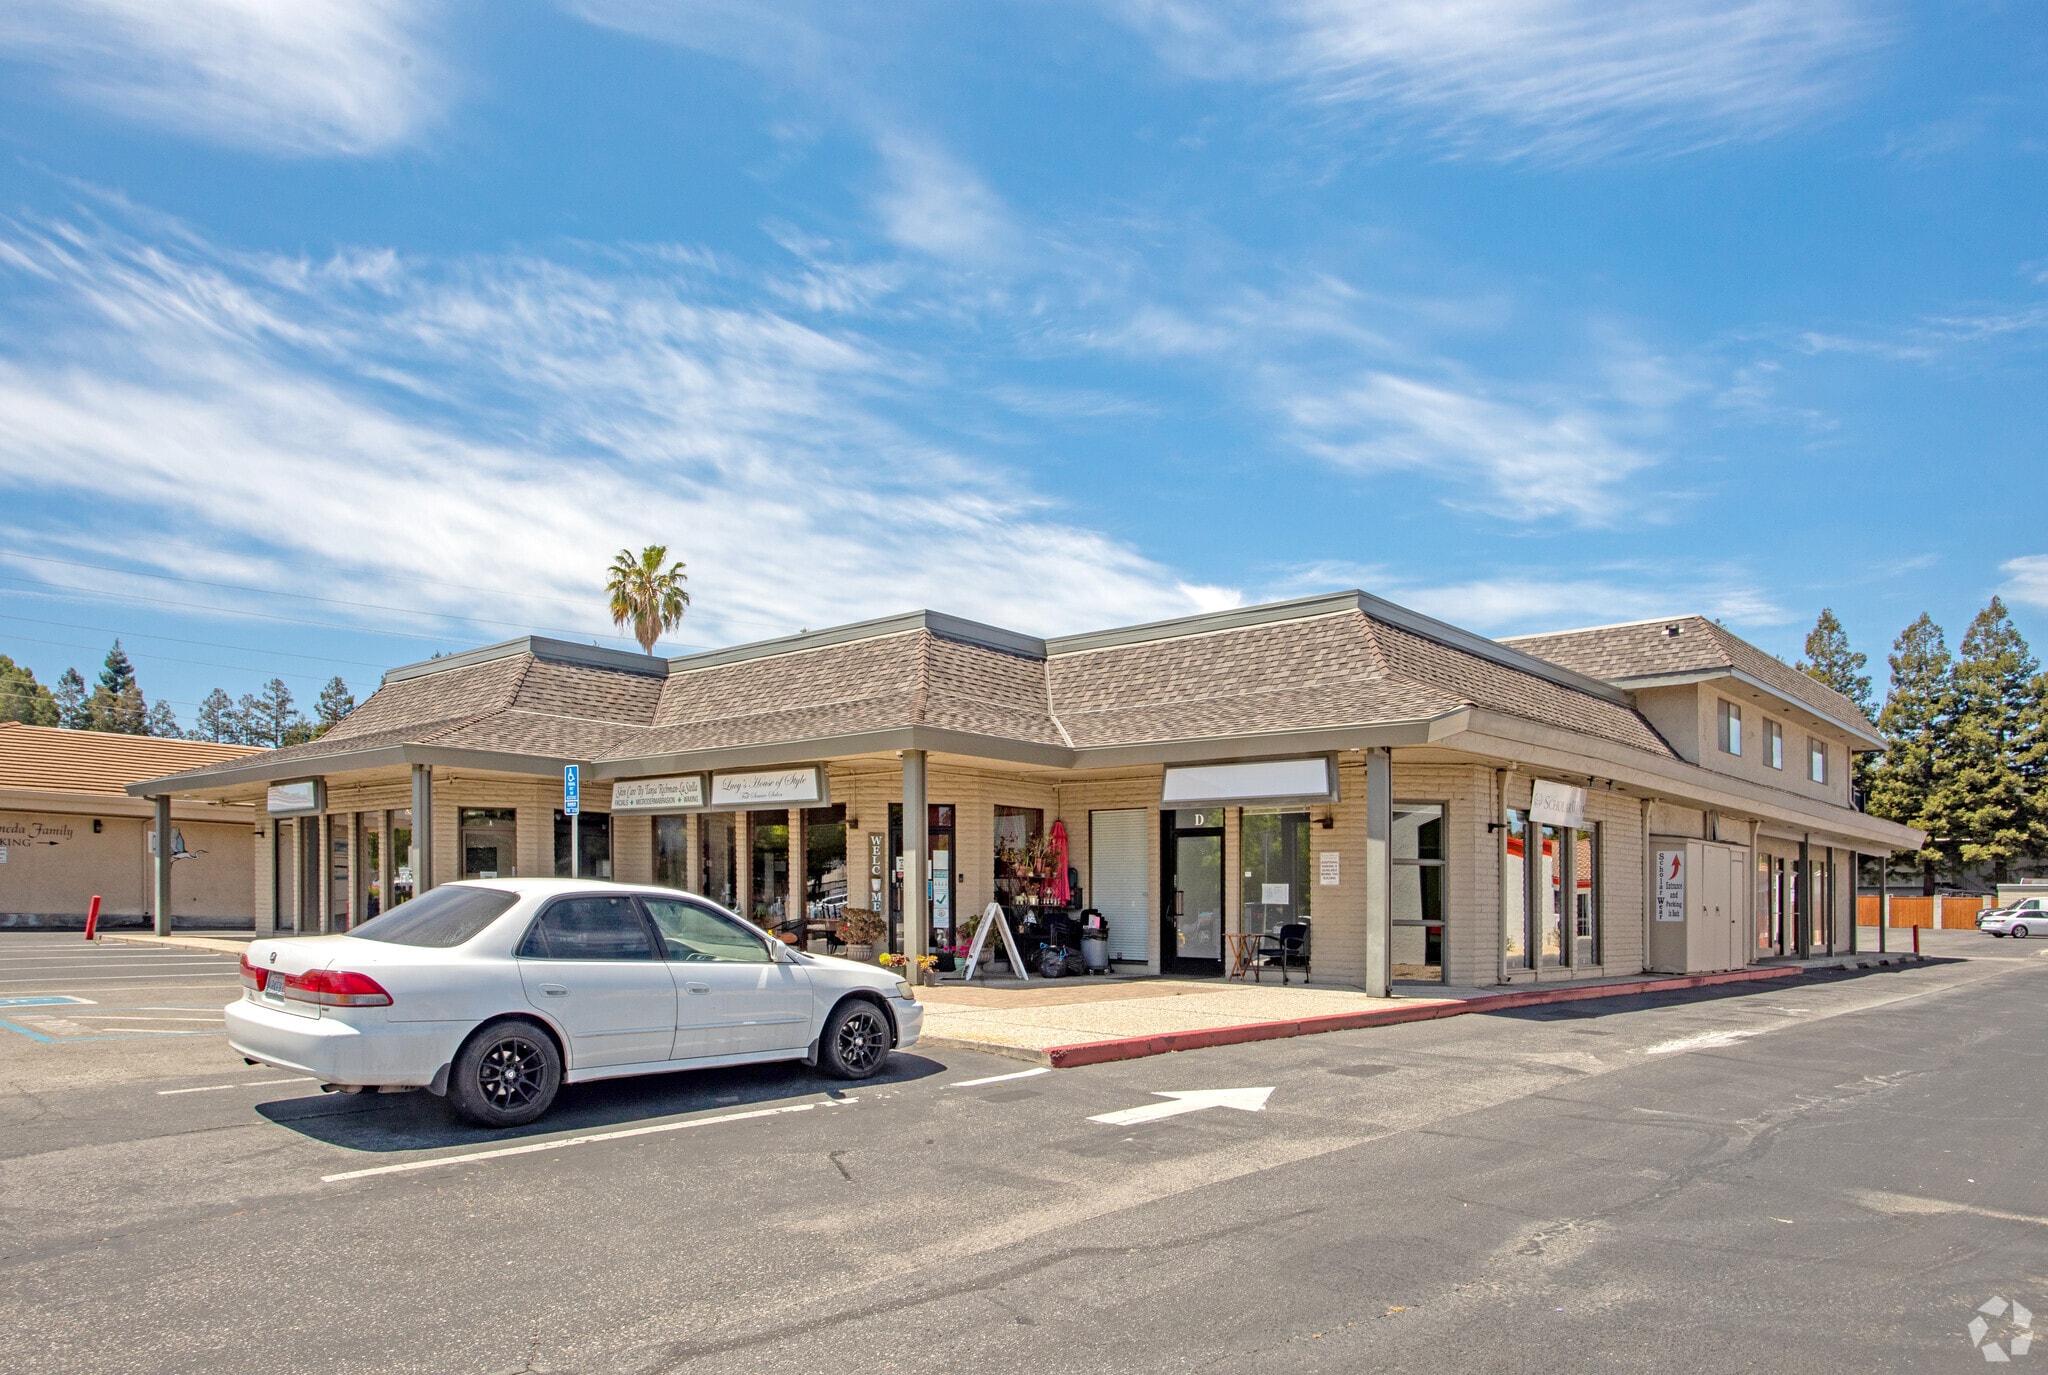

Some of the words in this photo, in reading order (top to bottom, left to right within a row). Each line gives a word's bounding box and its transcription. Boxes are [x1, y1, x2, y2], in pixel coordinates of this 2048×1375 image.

[722, 778, 747, 794] Lucy's
[748, 775, 774, 788] House
[775, 776, 784, 789] of
[784, 774, 806, 789] Style
[1195, 814, 1204, 825] D
[28, 822, 74, 840] Family
[1666, 882, 1683, 890] Entrance
[1657, 897, 1665, 919] Wear
[1666, 901, 1682, 909] Parking
